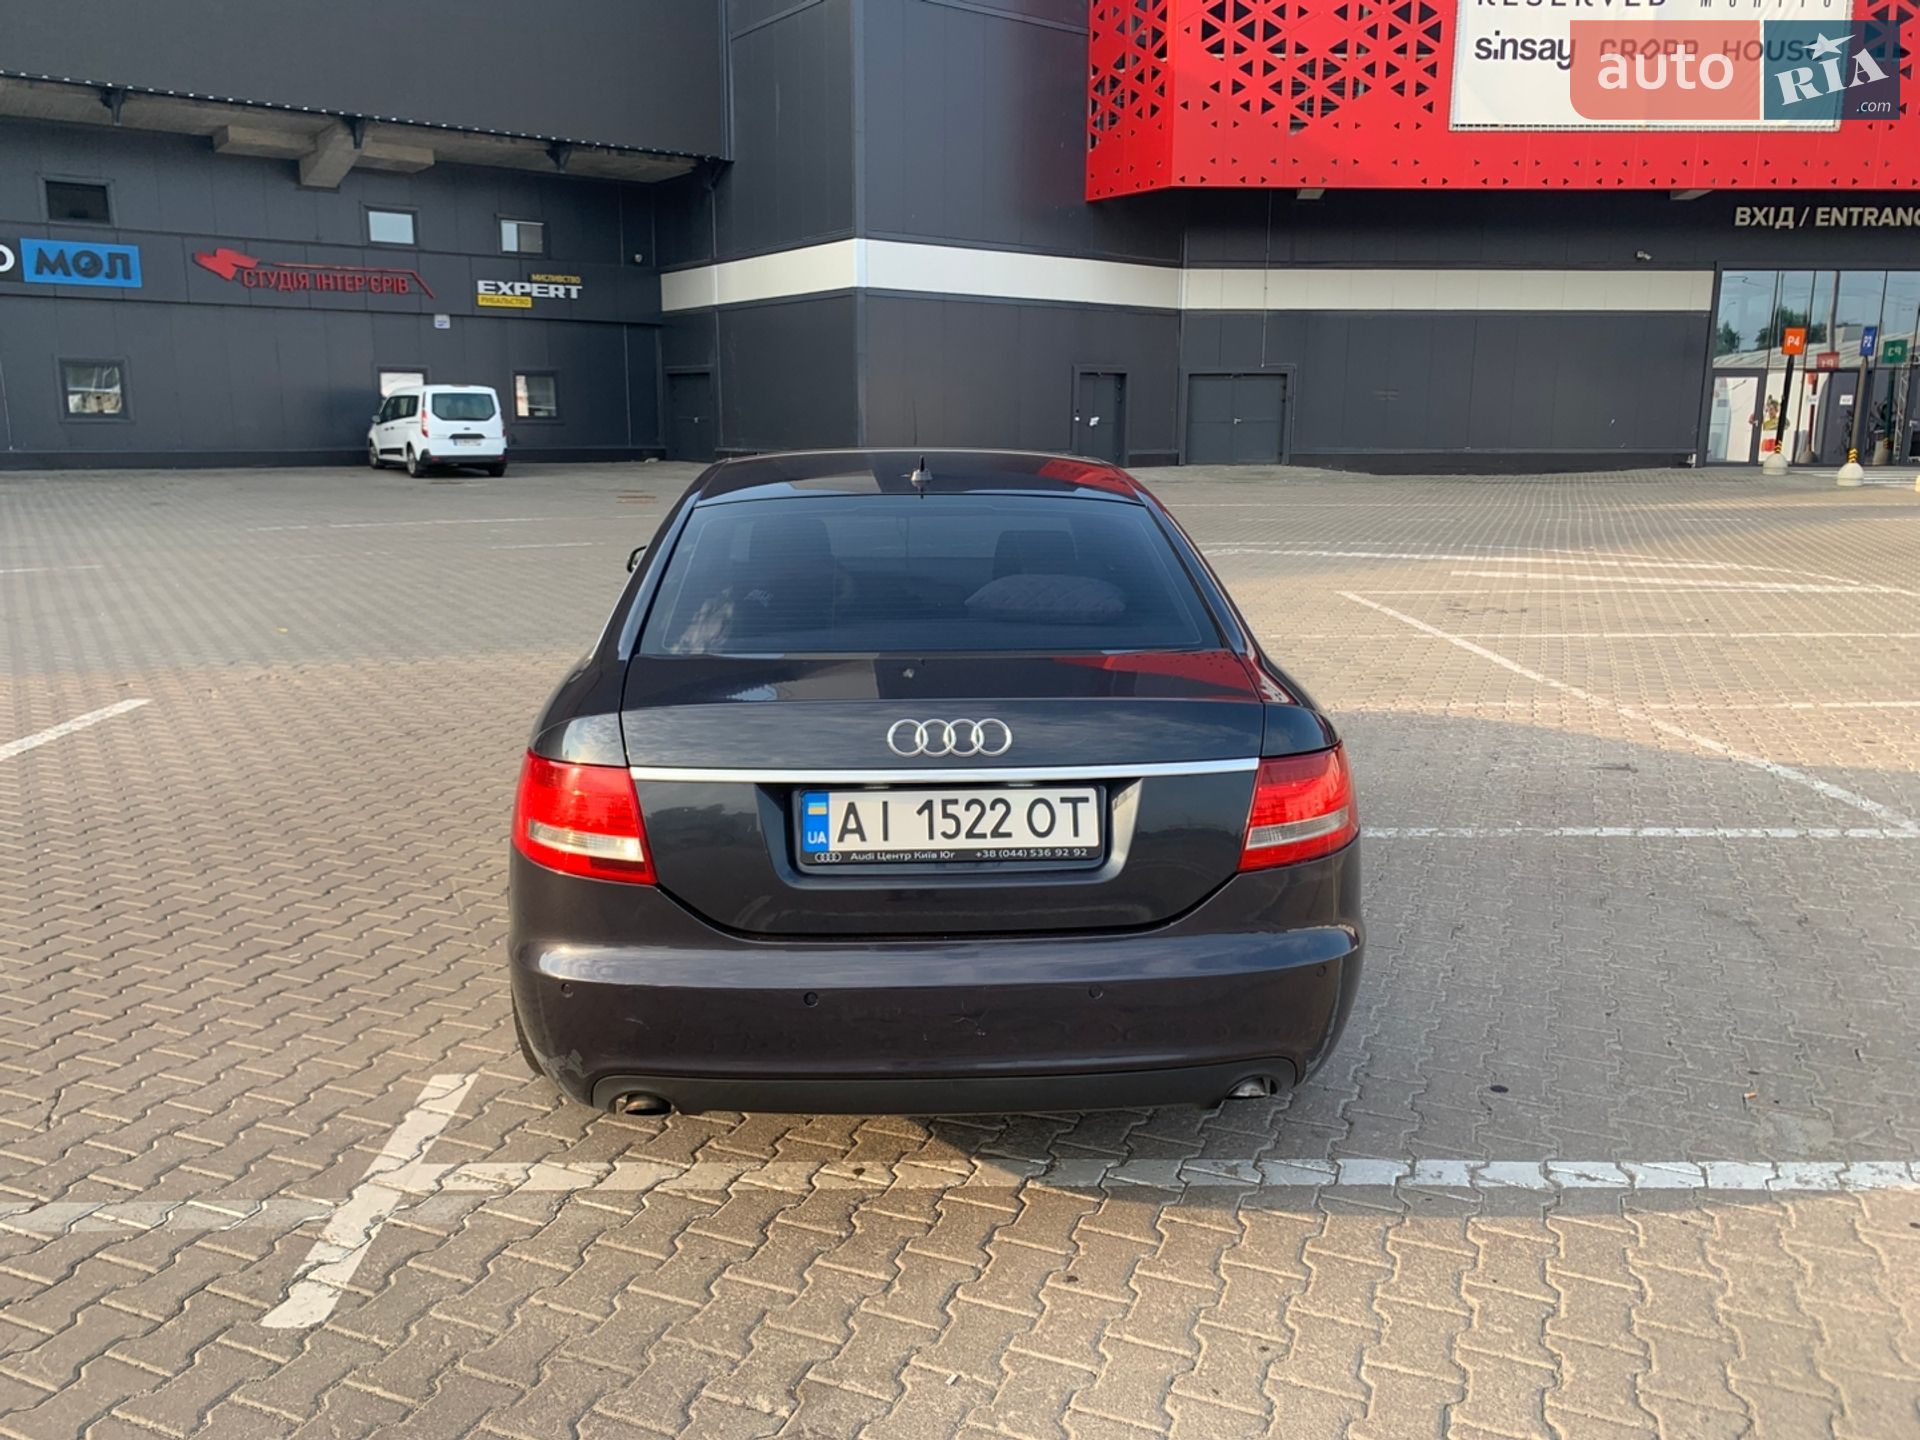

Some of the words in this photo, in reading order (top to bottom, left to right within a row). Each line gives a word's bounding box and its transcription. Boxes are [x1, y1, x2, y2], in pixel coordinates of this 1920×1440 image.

[1474, 30, 1576, 69] sinsay
[1734, 206, 1795, 229] ВХІД
[35, 248, 131, 280] МОЛ
[242, 270, 310, 293] СТУДІЯ
[477, 280, 582, 299] EXPERT
[1786, 336, 1801, 346] P4
[1862, 335, 1872, 348] P2
[807, 830, 827, 844] UA
[837, 801, 890, 843] AI
[916, 797, 1013, 840] 1522
[1026, 796, 1090, 838] OT
[850, 852, 875, 861] Audi
[877, 852, 911, 861] Центр
[914, 850, 937, 859] Київ
[975, 849, 996, 858] +38
[999, 848, 1027, 858] (044)
[1029, 848, 1051, 857] 536
[1055, 848, 1069, 857] 92
[1073, 847, 1088, 857] 92
